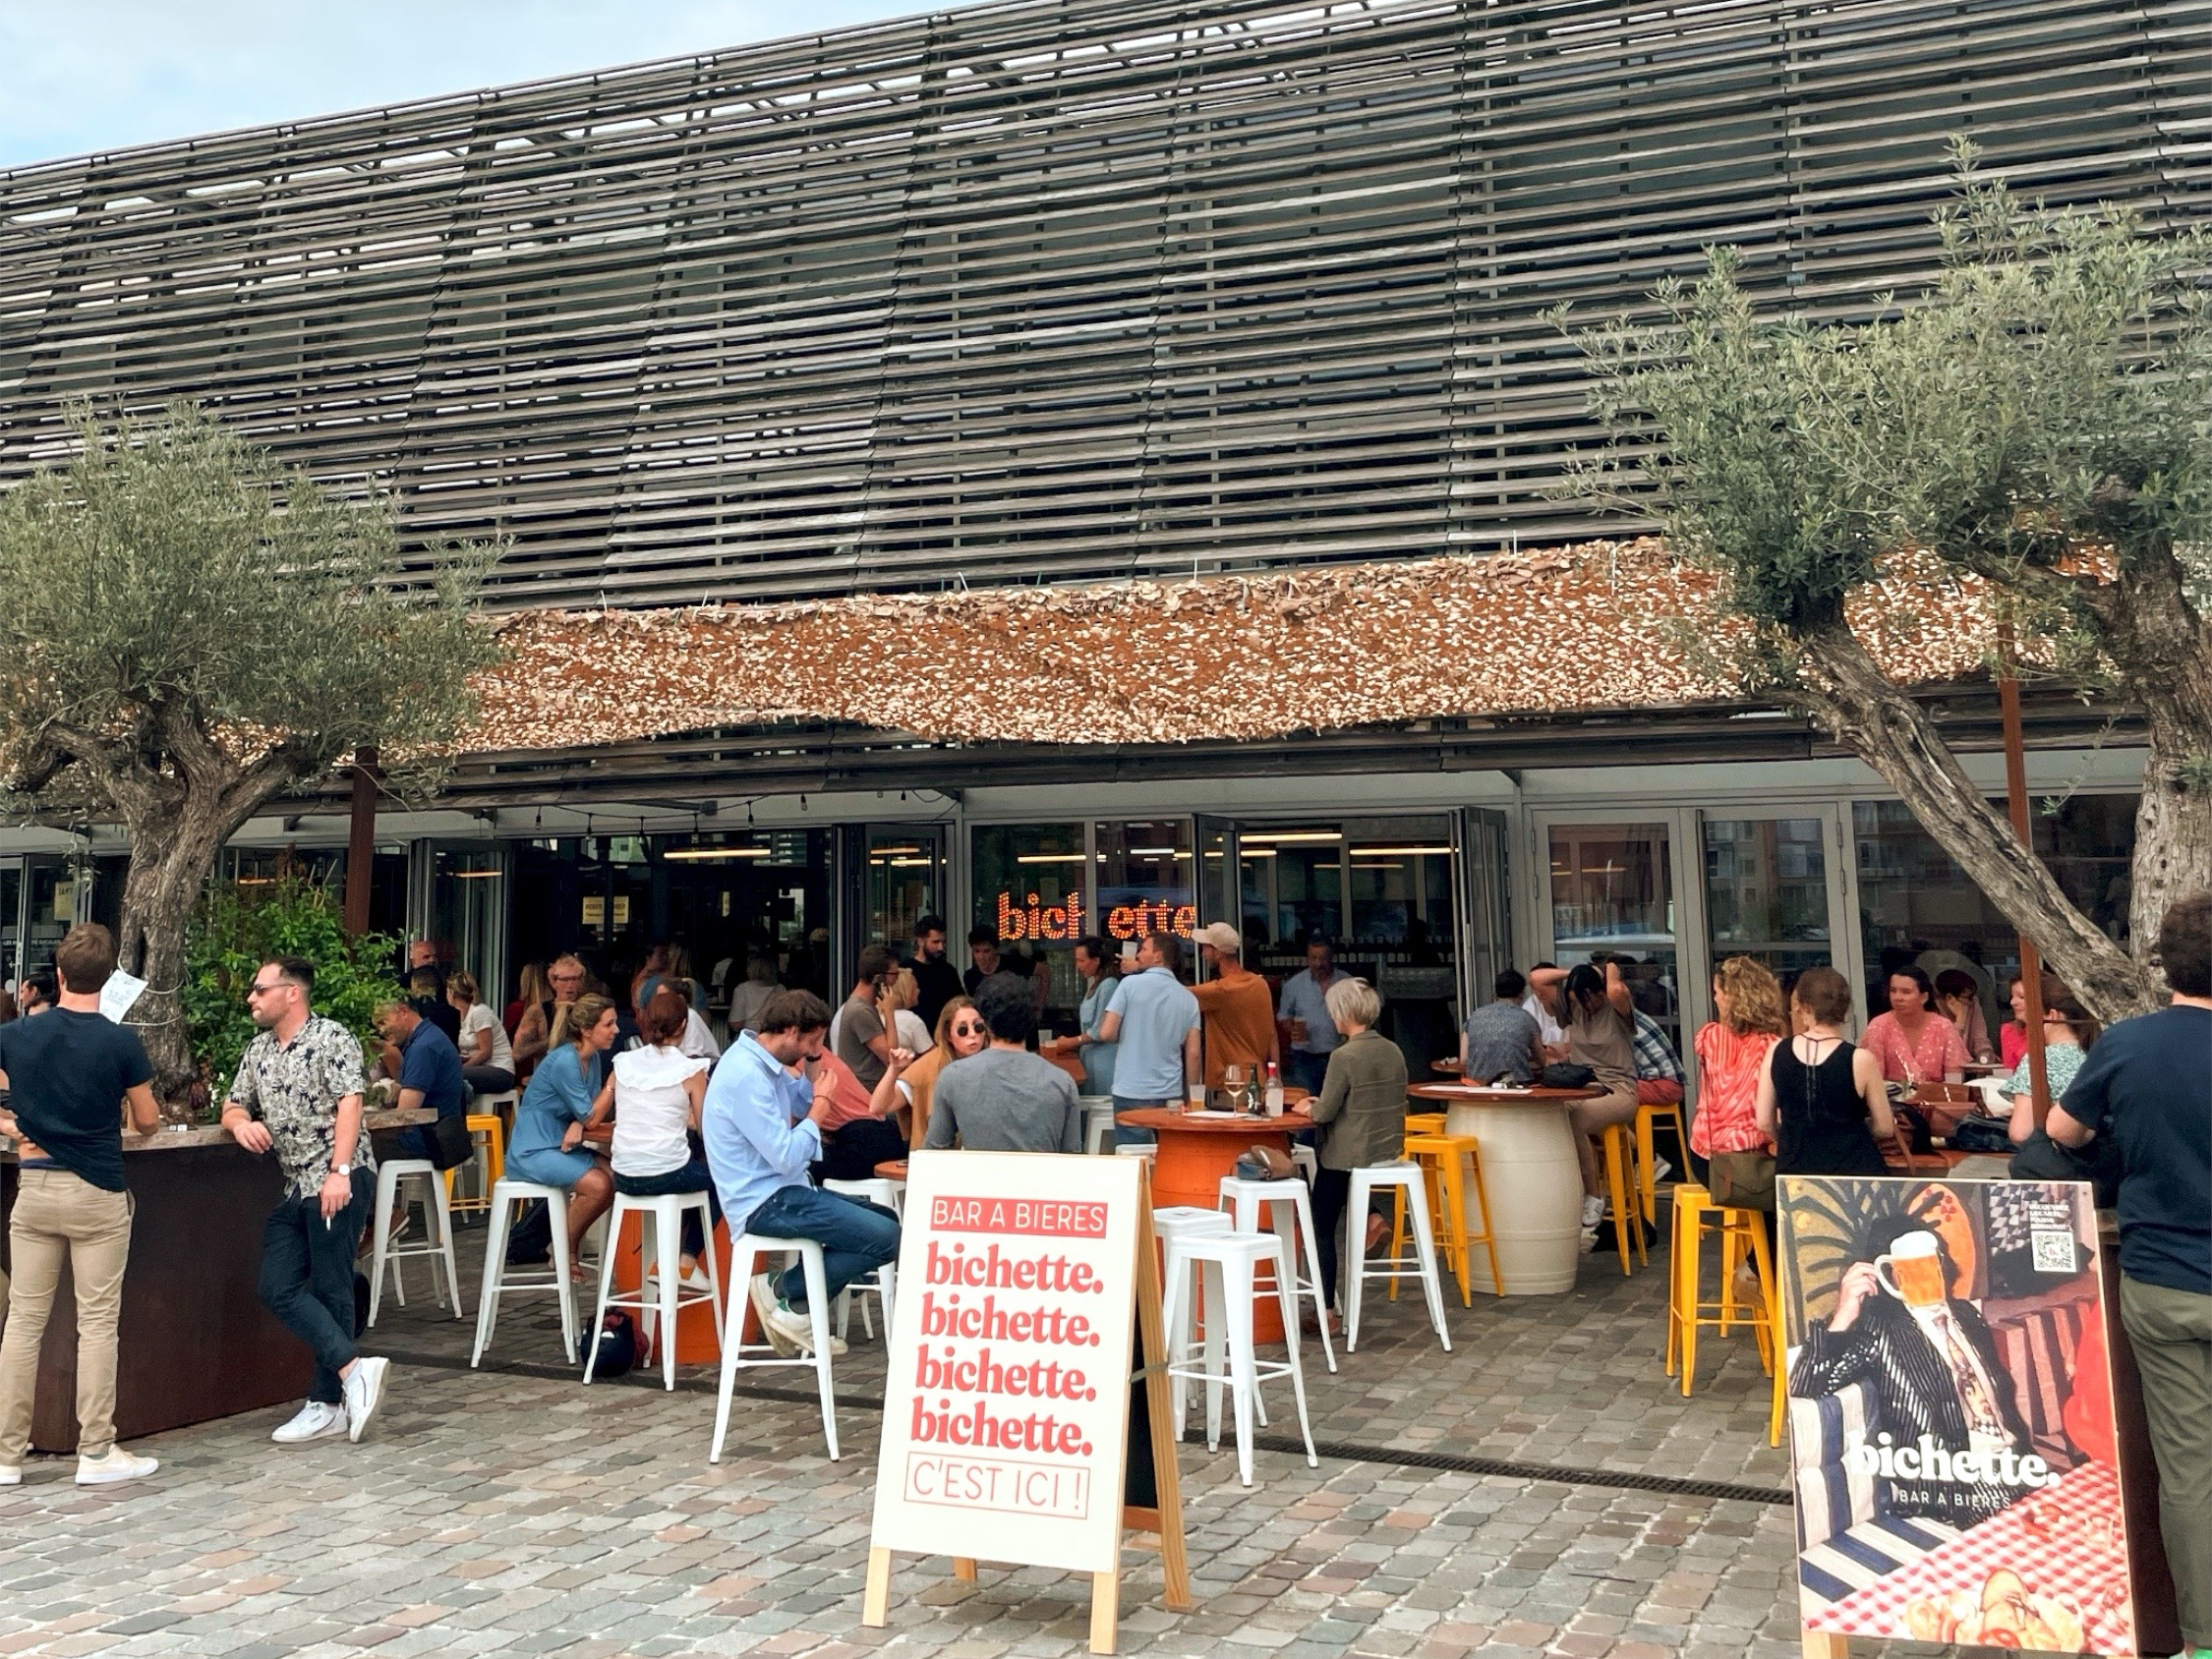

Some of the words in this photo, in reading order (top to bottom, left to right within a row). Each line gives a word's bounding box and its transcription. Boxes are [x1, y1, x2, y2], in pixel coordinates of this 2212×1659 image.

[933, 1199, 982, 1227] BAR
[989, 1202, 1006, 1228] A
[1015, 1202, 1105, 1232] BIERES
[926, 1240, 1104, 1294] bichette.
[921, 1291, 1100, 1347] bichette.
[915, 1344, 1096, 1402] bichette.
[910, 1396, 1093, 1457] bichette.
[913, 1459, 1004, 1502] C'EST
[1016, 1469, 1060, 1509] ICI
[1846, 1430, 2062, 1488] bichette.
[1898, 1489, 1930, 1506] BAR
[1937, 1491, 1948, 1507] A
